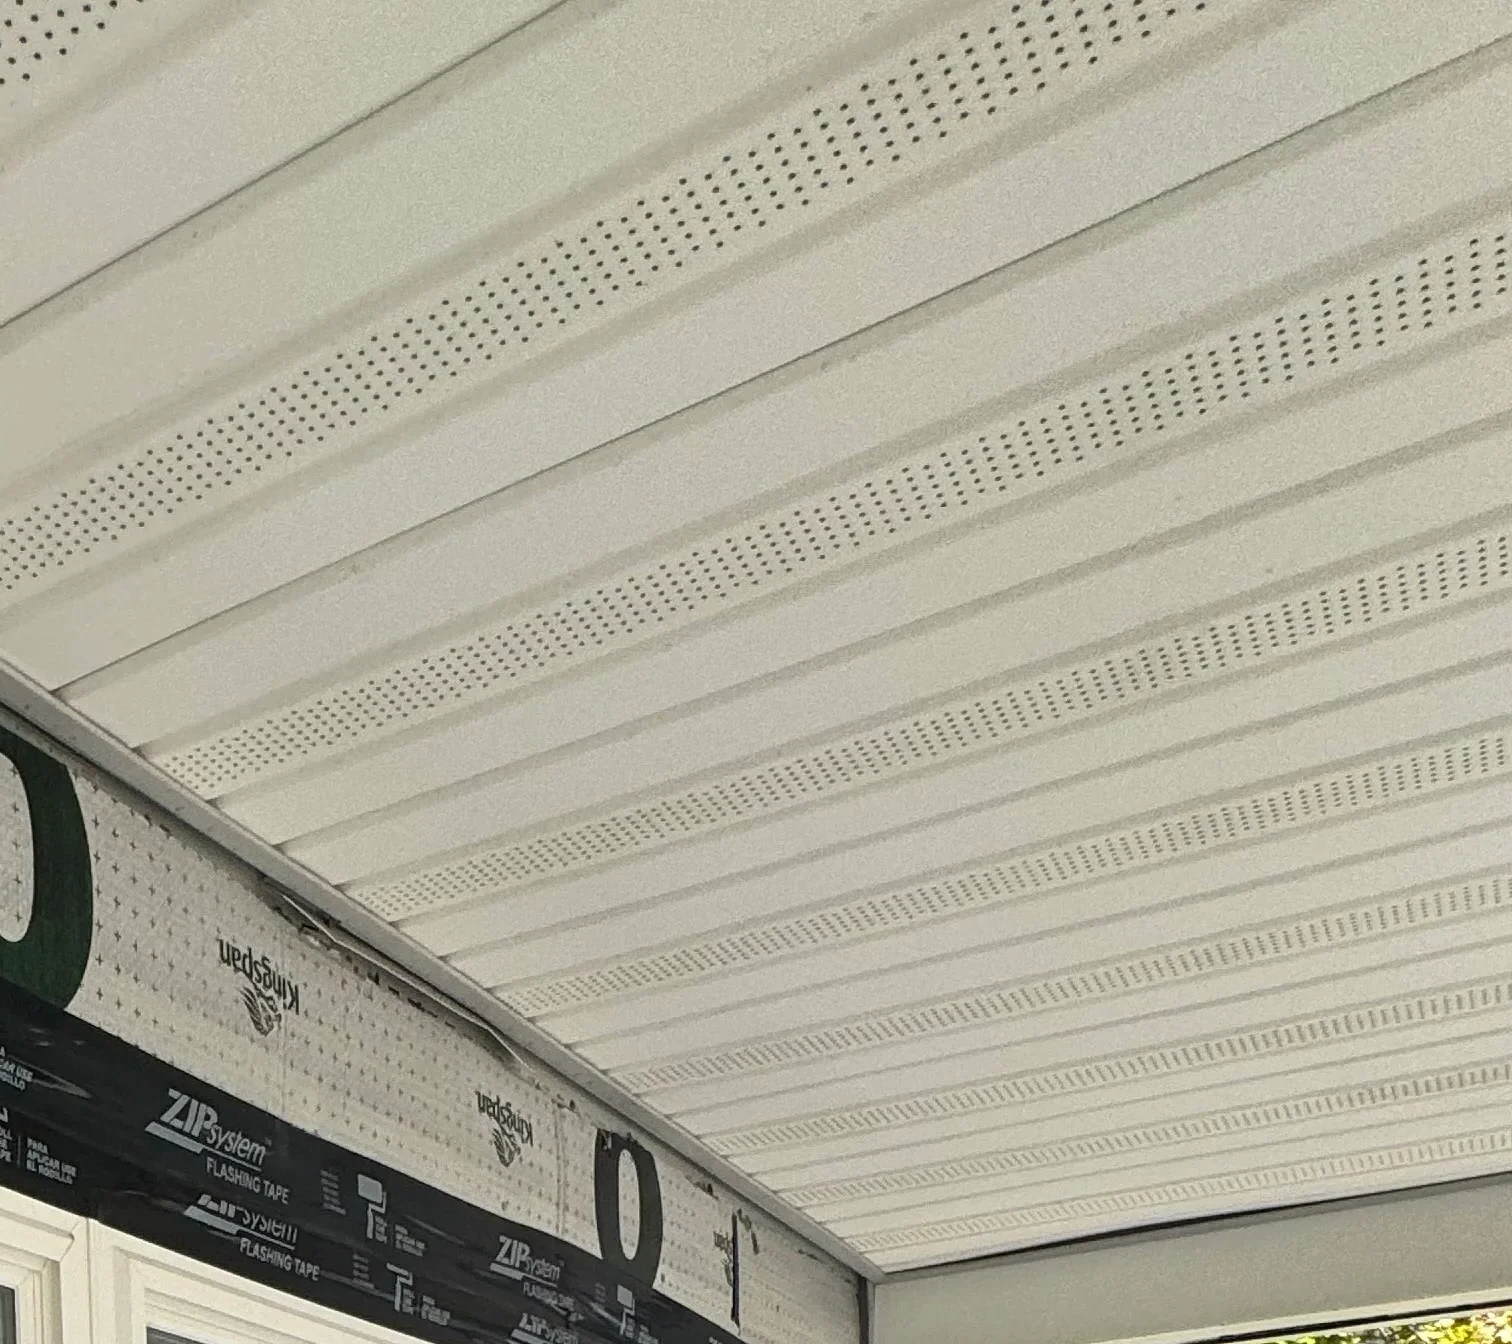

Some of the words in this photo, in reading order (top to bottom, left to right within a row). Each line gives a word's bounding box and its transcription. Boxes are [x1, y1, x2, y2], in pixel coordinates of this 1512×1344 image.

[218, 938, 299, 1014] Kingspan
[474, 1089, 534, 1147] Kingspan
[206, 1156, 260, 1194] FLASHING
[263, 1180, 290, 1206] TAPE
[239, 1237, 292, 1272] FLASHING
[294, 1258, 320, 1281] TAPE
